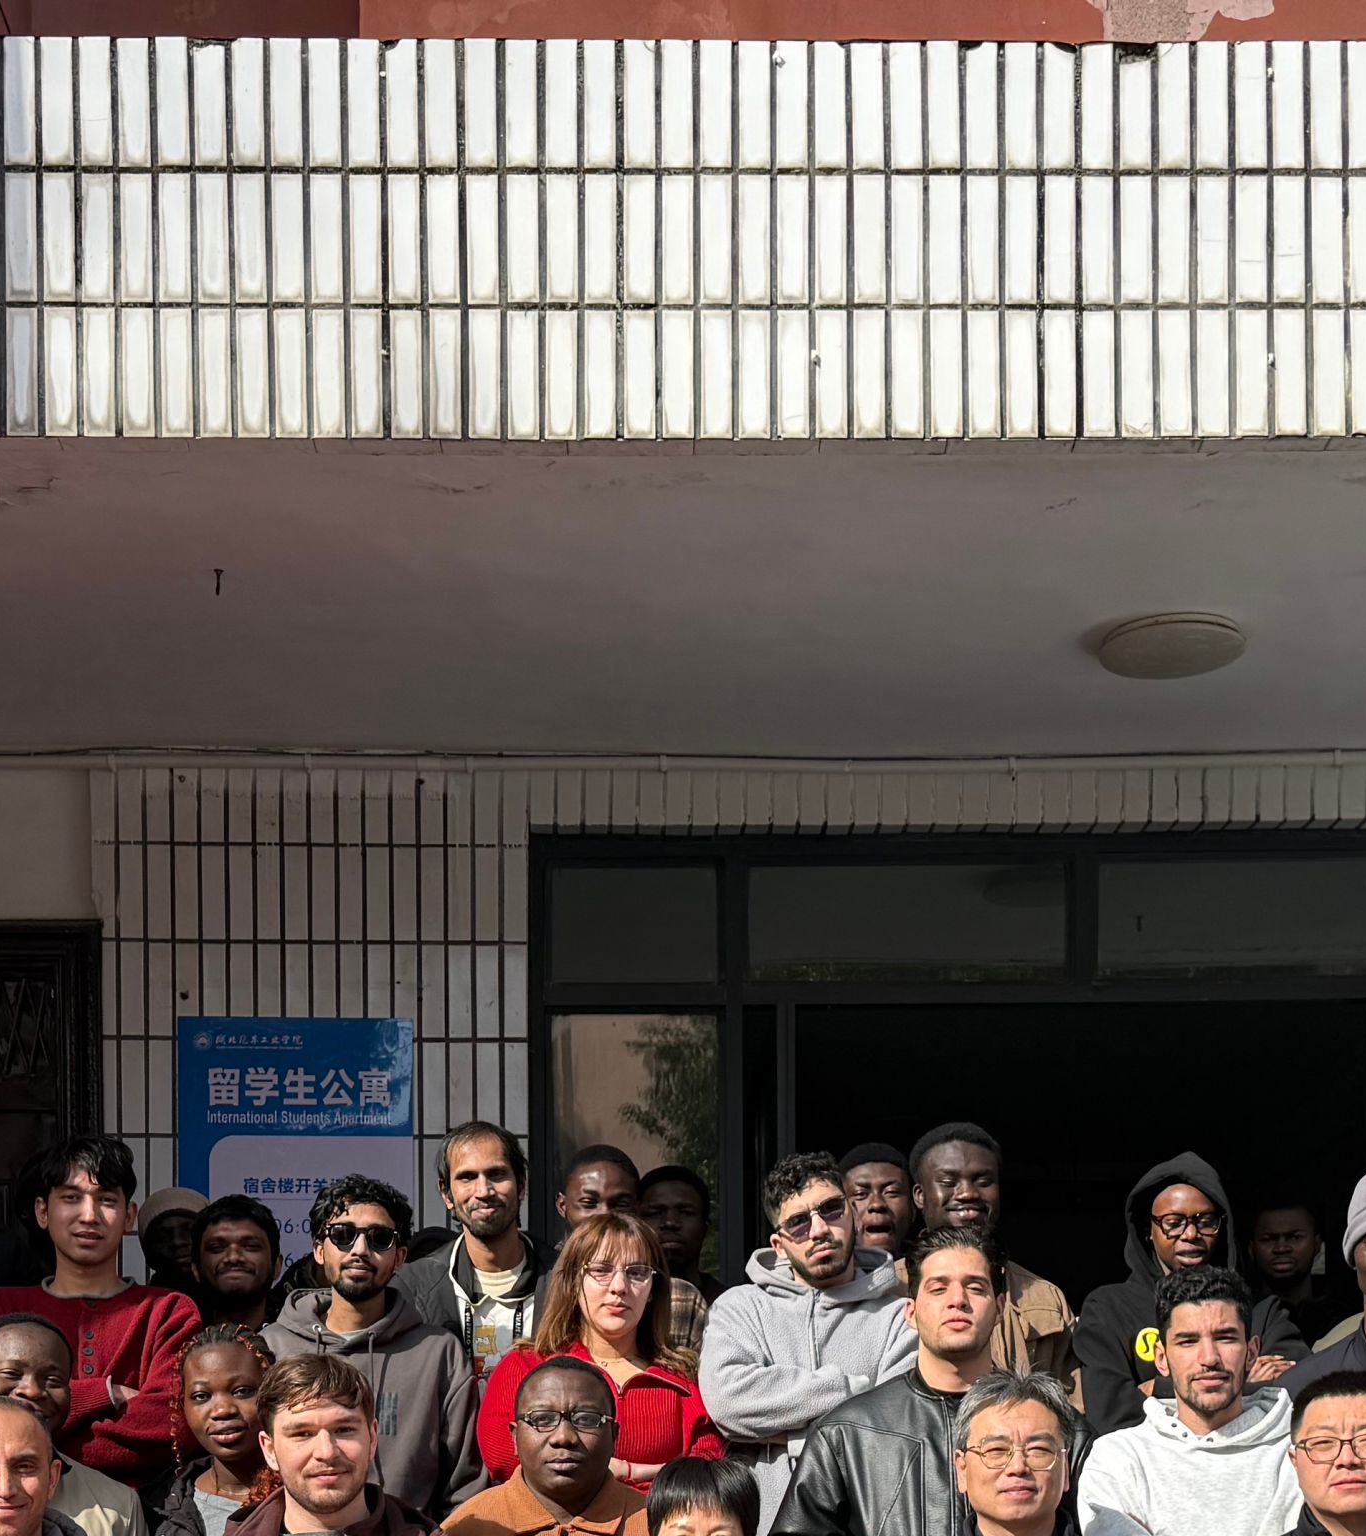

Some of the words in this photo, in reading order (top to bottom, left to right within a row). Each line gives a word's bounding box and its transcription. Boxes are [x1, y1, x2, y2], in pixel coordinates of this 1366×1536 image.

[207, 1067, 391, 1107] 留学生公寓
[207, 1110, 278, 1125] International
[281, 1110, 331, 1125] Students
[334, 1111, 392, 1127] Apartment
